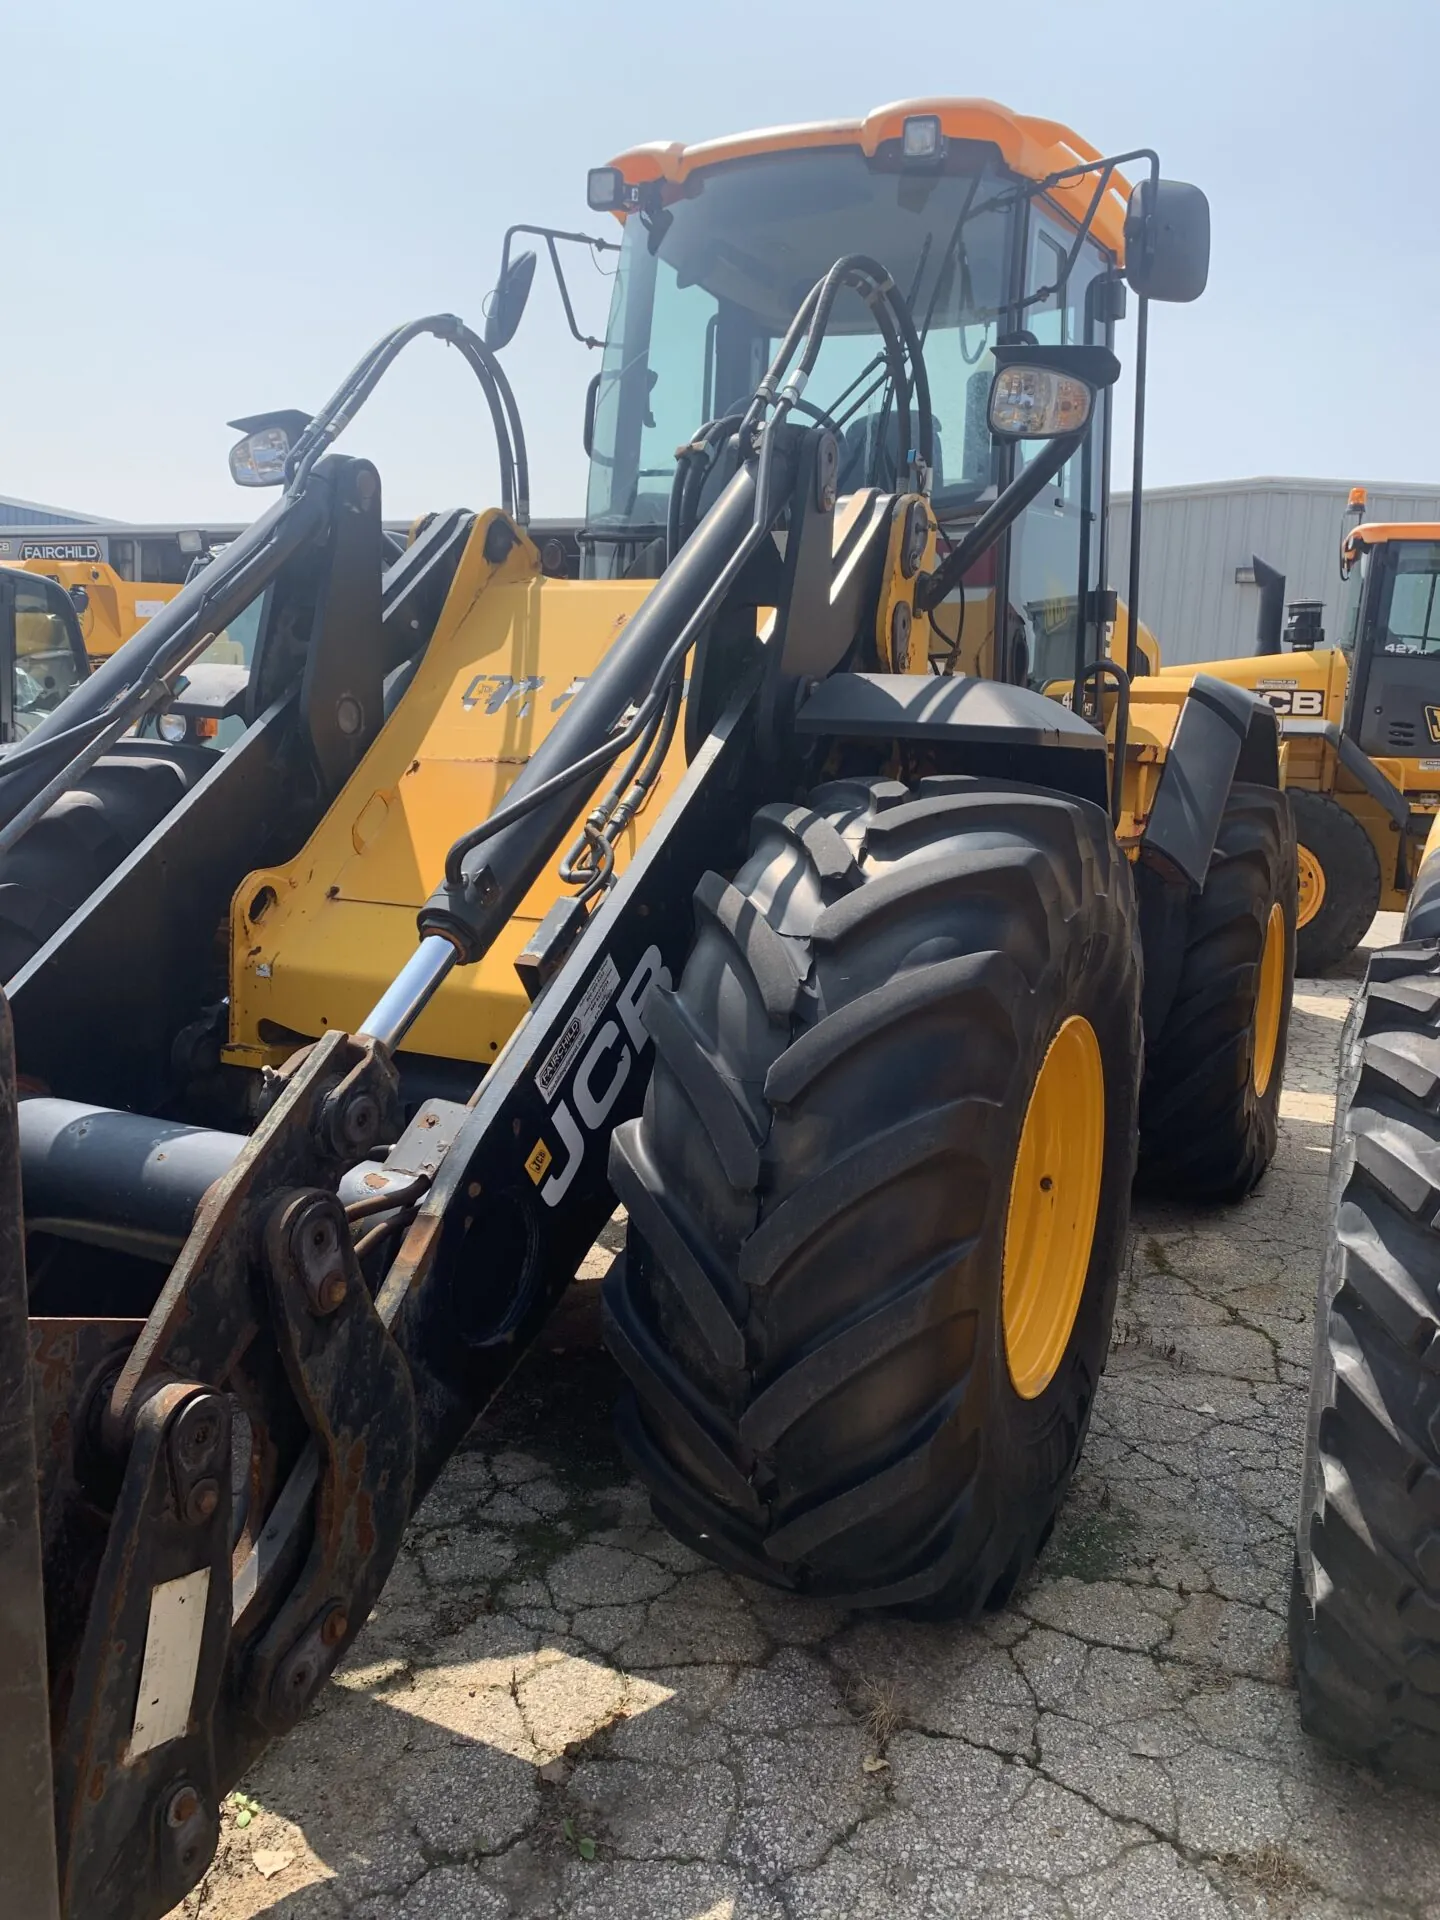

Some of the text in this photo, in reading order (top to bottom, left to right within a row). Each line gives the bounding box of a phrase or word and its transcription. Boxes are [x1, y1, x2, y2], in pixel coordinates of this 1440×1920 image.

[24, 546, 98, 559] FAIRCHILD
[1264, 690, 1322, 715] CB
[540, 1019, 580, 1084] FAIRCHILD
[532, 1150, 546, 1171] JCB
